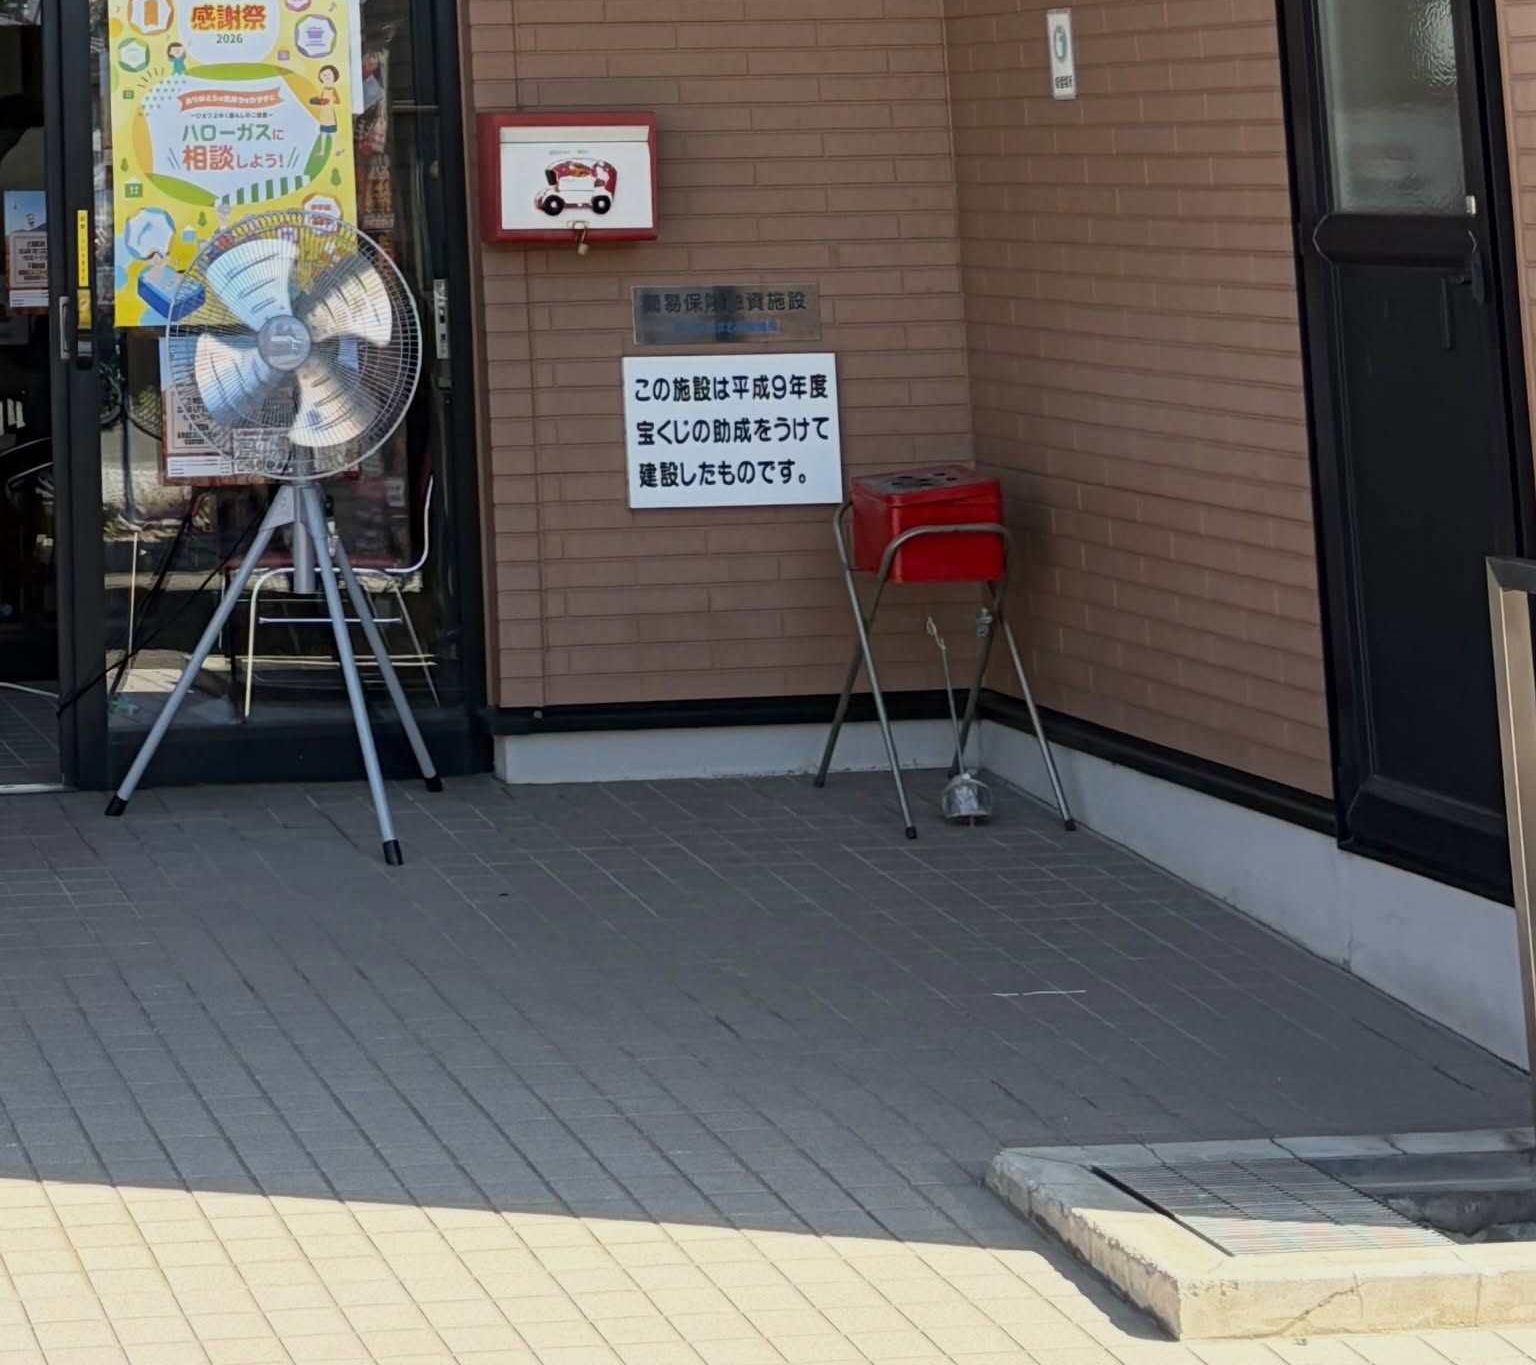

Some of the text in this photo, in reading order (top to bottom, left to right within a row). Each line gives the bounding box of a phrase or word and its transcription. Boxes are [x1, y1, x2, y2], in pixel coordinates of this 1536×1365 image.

[191, 4, 267, 31] 感謝祭
[216, 34, 243, 44] 2026
[182, 123, 285, 142] ハローガスに
[182, 144, 284, 171] 相談しよう!
[635, 374, 829, 402] この施設は平成9年度
[636, 417, 830, 446] 宝くじの助成をうけて
[639, 459, 807, 488] 建設したものです。
